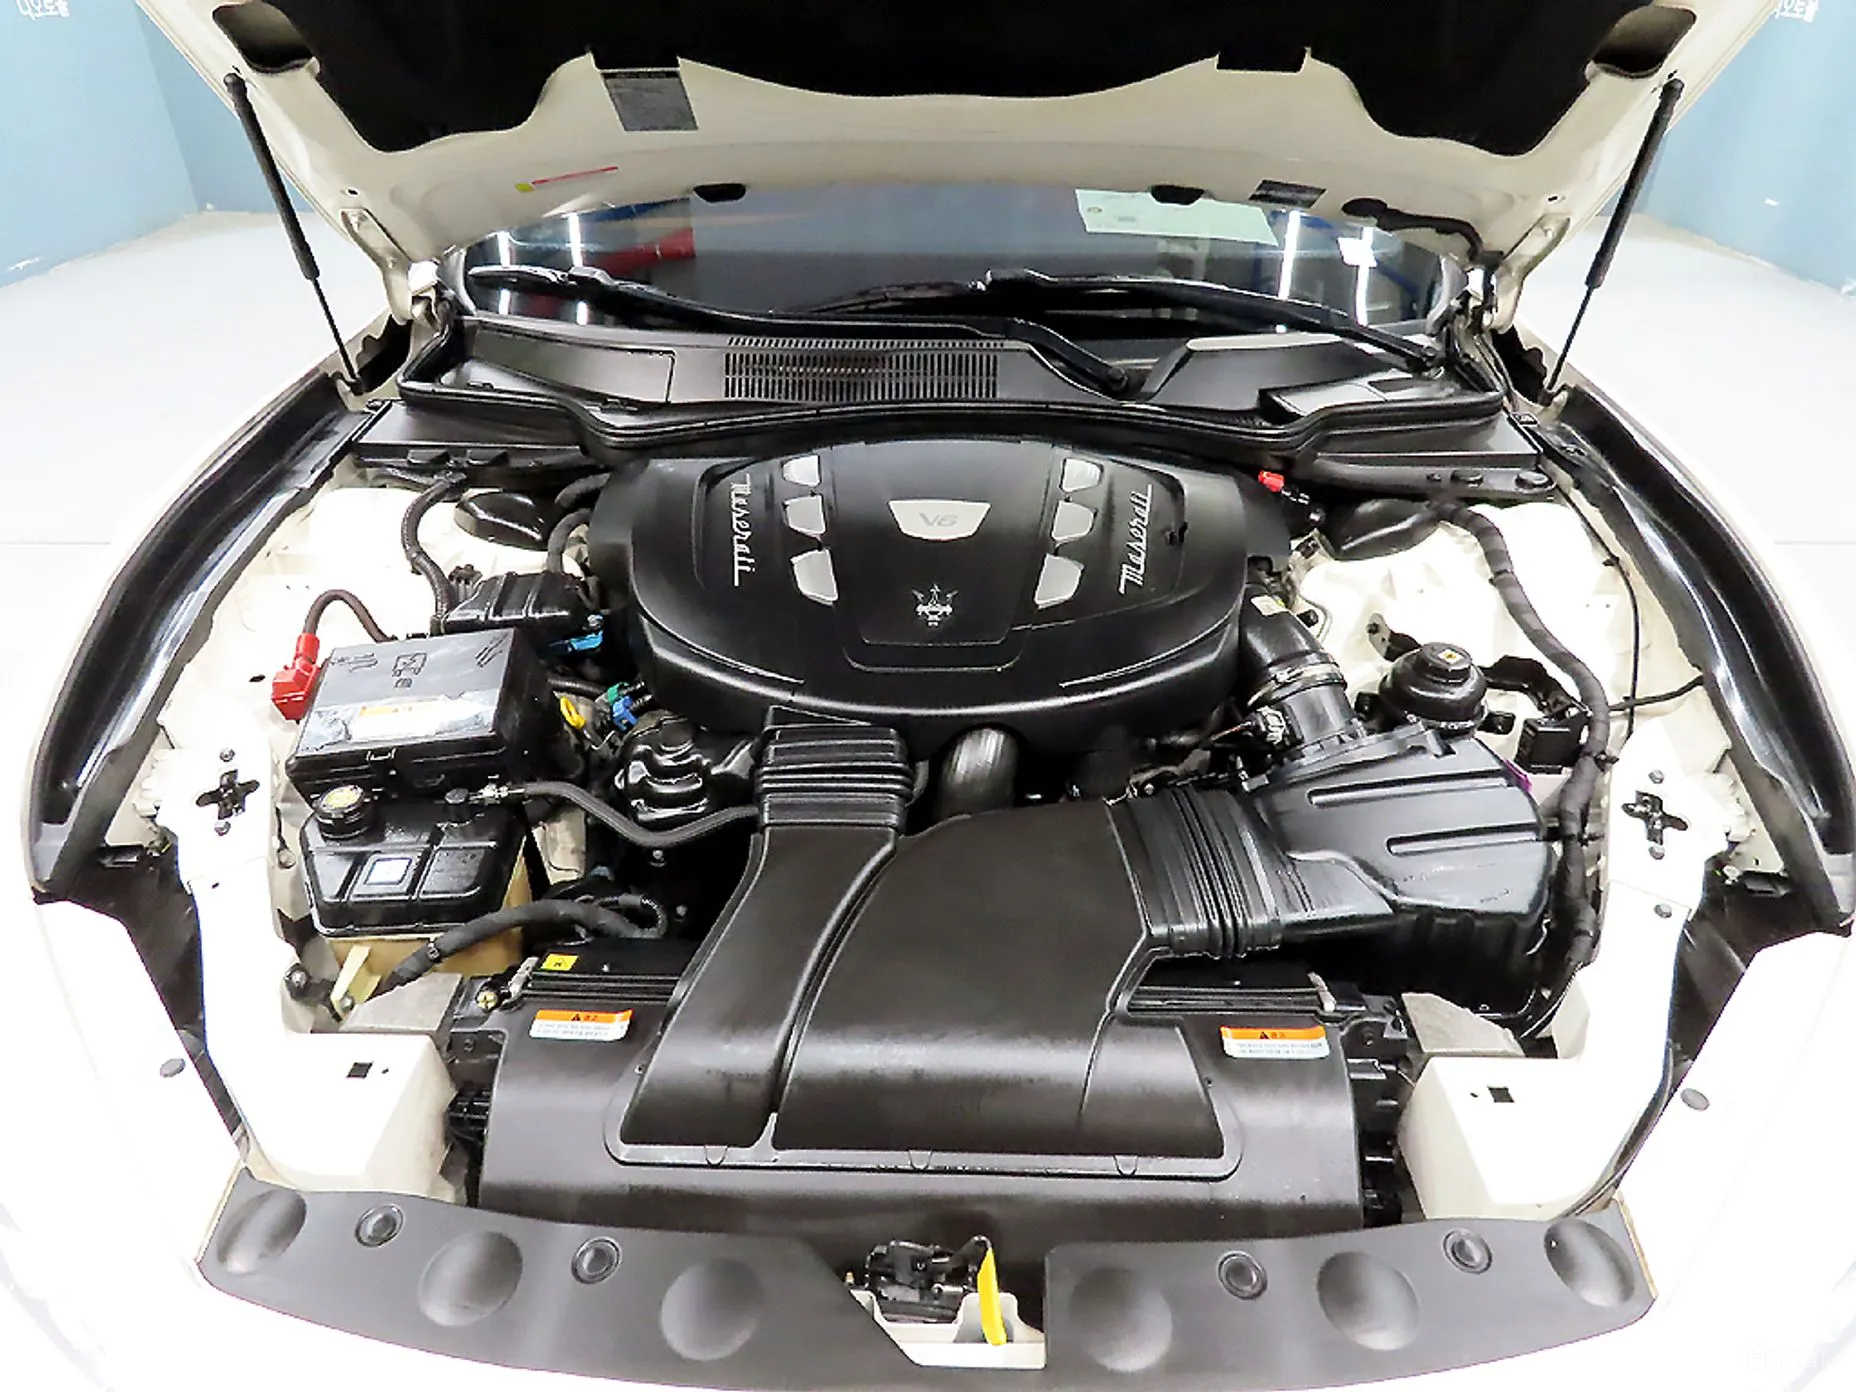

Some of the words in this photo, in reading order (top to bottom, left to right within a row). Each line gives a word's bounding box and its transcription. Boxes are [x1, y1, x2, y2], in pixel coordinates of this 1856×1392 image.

[731, 473, 756, 587] Maserati
[918, 512, 959, 527] V6
[1118, 484, 1153, 595] Maserati
